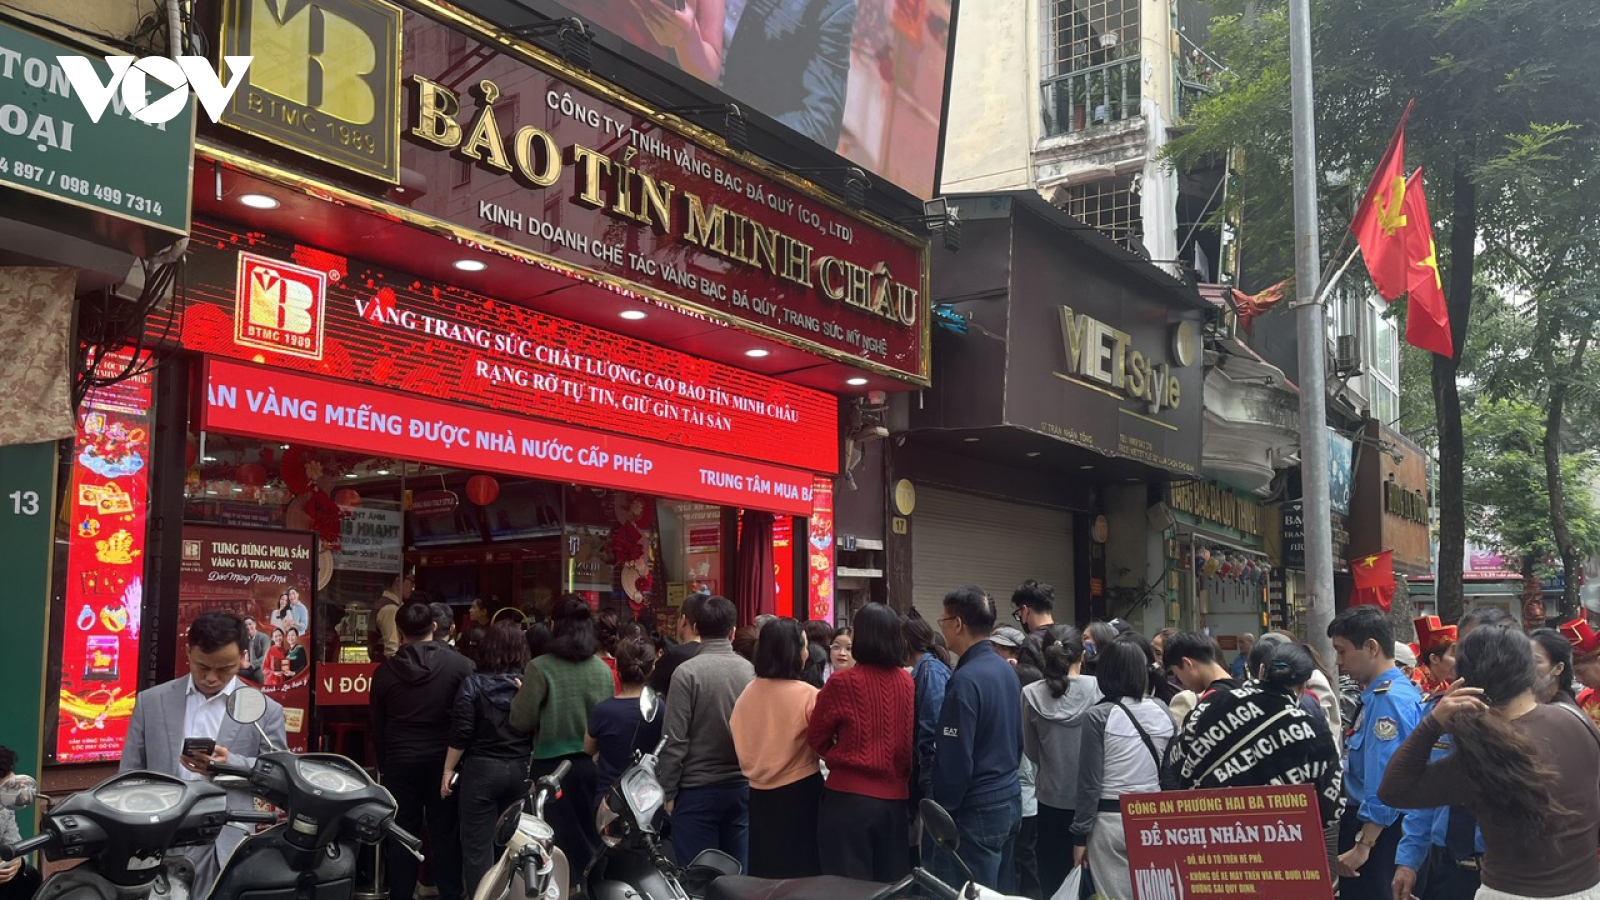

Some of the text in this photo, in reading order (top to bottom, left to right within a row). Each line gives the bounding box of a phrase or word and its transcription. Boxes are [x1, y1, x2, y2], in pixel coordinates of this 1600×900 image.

[248, 92, 376, 155] BTMC 1989
[547, 90, 600, 129] CÔNG
[602, 115, 625, 138] TY
[630, 128, 671, 161] TNHH
[674, 146, 711, 180] VÀNG
[714, 170, 743, 195] BẠC
[746, 183, 764, 203] ĐÁ
[767, 193, 794, 216] QUÝ
[13, 161, 45, 182] 897
[59, 175, 90, 195] 098
[93, 184, 122, 204] 499
[125, 194, 163, 216] 7314
[412, 74, 919, 327] BẢO TÍN MINH CHÂU
[479, 200, 523, 231] KINH
[528, 217, 589, 254] DOANH
[590, 239, 624, 266] CHẾ
[628, 251, 656, 276] TÁC
[659, 262, 696, 290] VÀNG
[732, 289, 750, 310] ĐÁ
[783, 307, 820, 332] TRANG
[823, 319, 844, 340] SỨC
[248, 325, 280, 341] BTMC
[354, 297, 799, 423] VÀNG TRANG SỨC CHẤT LƯỢNG CAO BẢO TÍN MINH CHÂU
[476, 359, 529, 386] RẠNG
[533, 372, 559, 393] RỠ
[561, 380, 587, 403] TỰ
[589, 386, 619, 409] TIN,
[621, 394, 652, 414] GIỮ
[653, 400, 679, 420] GÌN
[681, 406, 704, 426] TÀI
[245, 386, 318, 422] VÀNG
[408, 418, 470, 449] ĐƯỢC
[476, 429, 516, 455] NHÀ
[521, 437, 574, 463] NƯỚC
[578, 445, 610, 468] CẤP
[613, 454, 654, 475] PHÉP
[699, 469, 743, 490] TRUNG
[745, 475, 771, 494] TÂM
[774, 482, 799, 500] MUA
[9, 490, 40, 515] 13
[896, 520, 905, 531] 17
[1285, 515, 1305, 528] BẠ
[211, 556, 293, 571] VÀNG VÀ TRANG SỨC
[269, 545, 289, 558] MUA
[291, 544, 310, 559] SẮM
[1127, 799, 1156, 816] CÔNG
[1159, 800, 1174, 814] AN
[1225, 796, 1245, 810] HAI
[1268, 793, 1308, 808] TRƯNG
[1140, 820, 1302, 849] ĐỀ NGHỊ NHÂN DÂN
[1213, 884, 1224, 893] SAI
